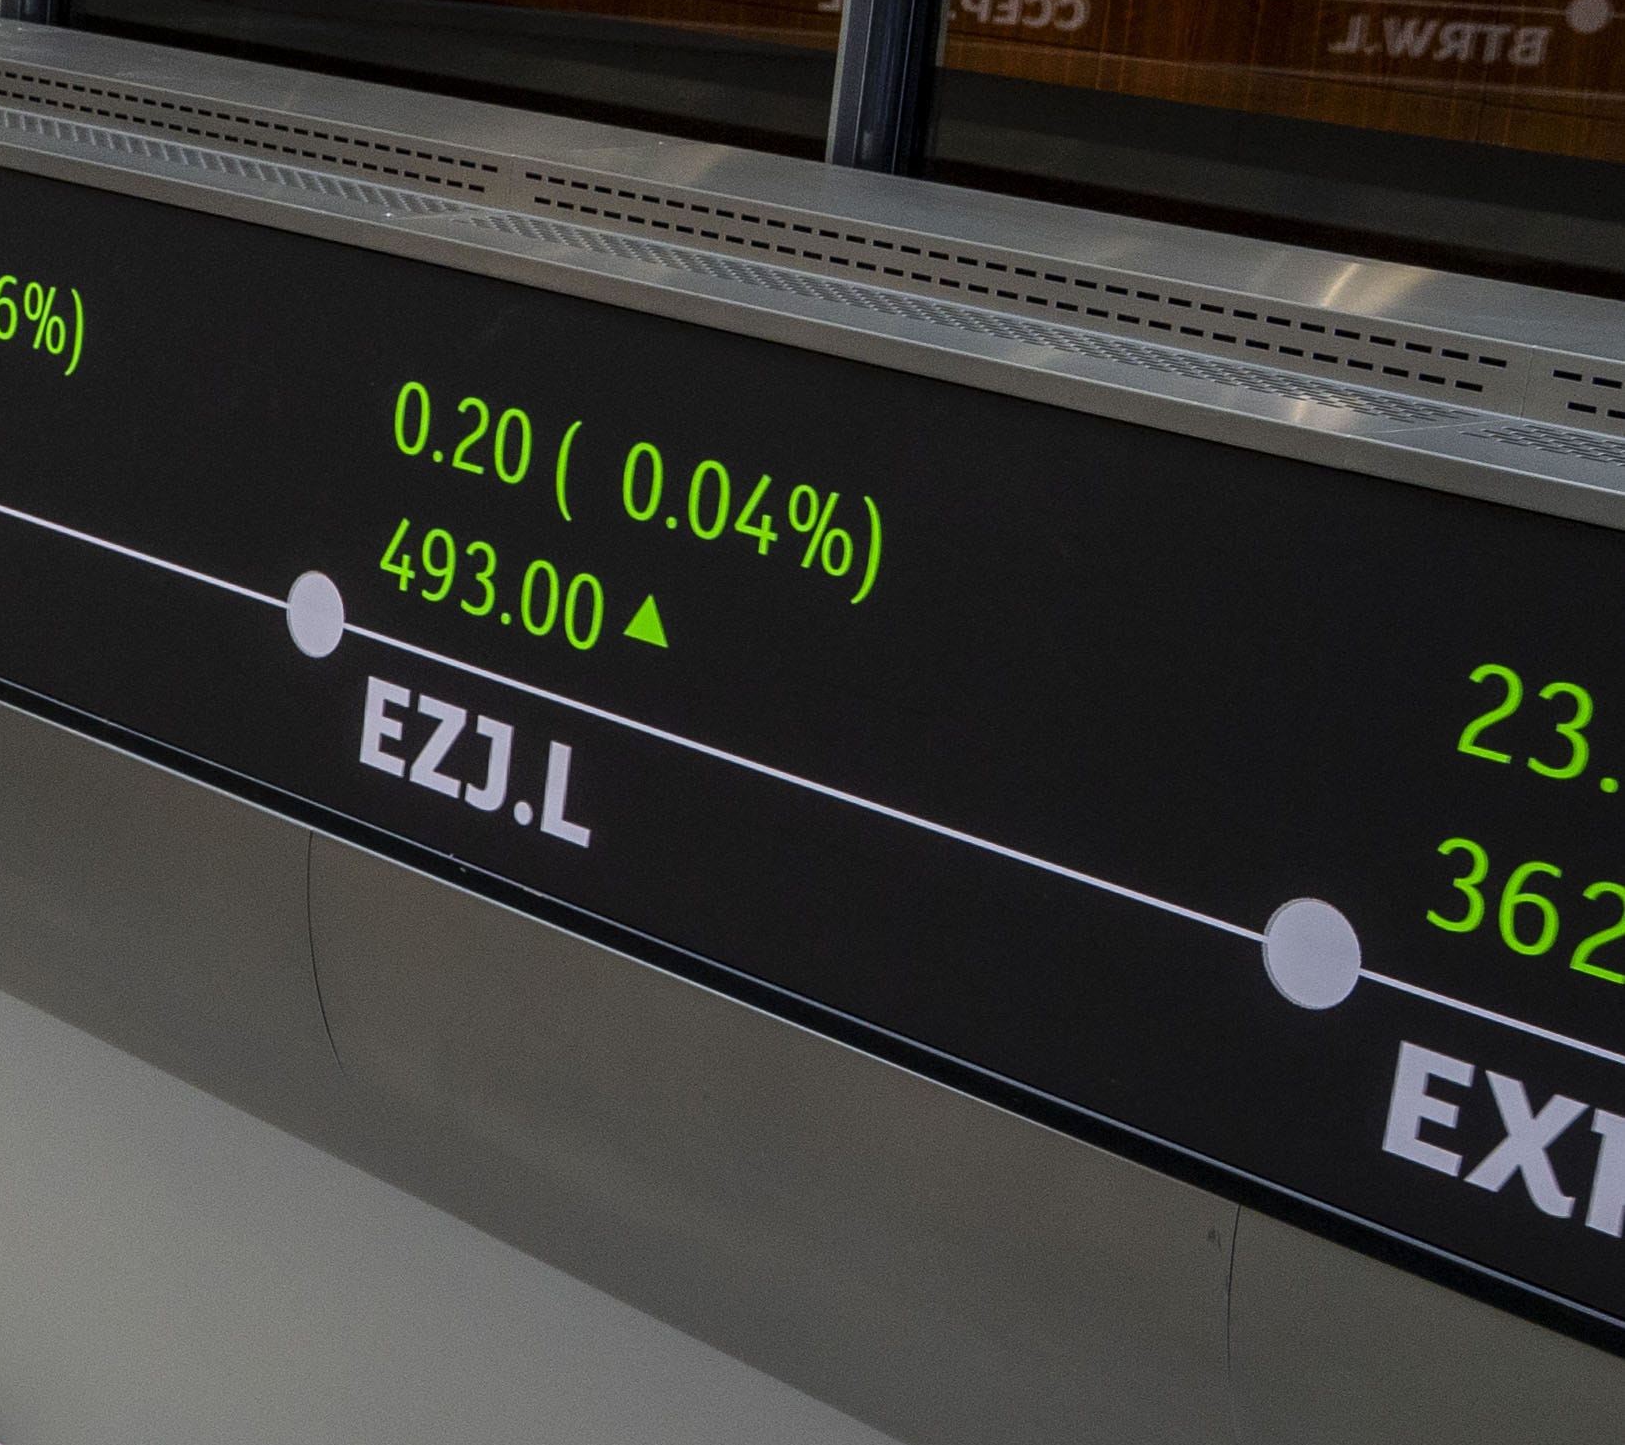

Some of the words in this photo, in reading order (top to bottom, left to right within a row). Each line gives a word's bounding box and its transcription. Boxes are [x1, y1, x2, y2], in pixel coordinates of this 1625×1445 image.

[394, 381, 532, 485] 0.20
[379, 517, 604, 651] 493.00
[359, 675, 591, 849] EZJ.L
[1457, 663, 1619, 794] 23.
[1426, 837, 1625, 985] 362
